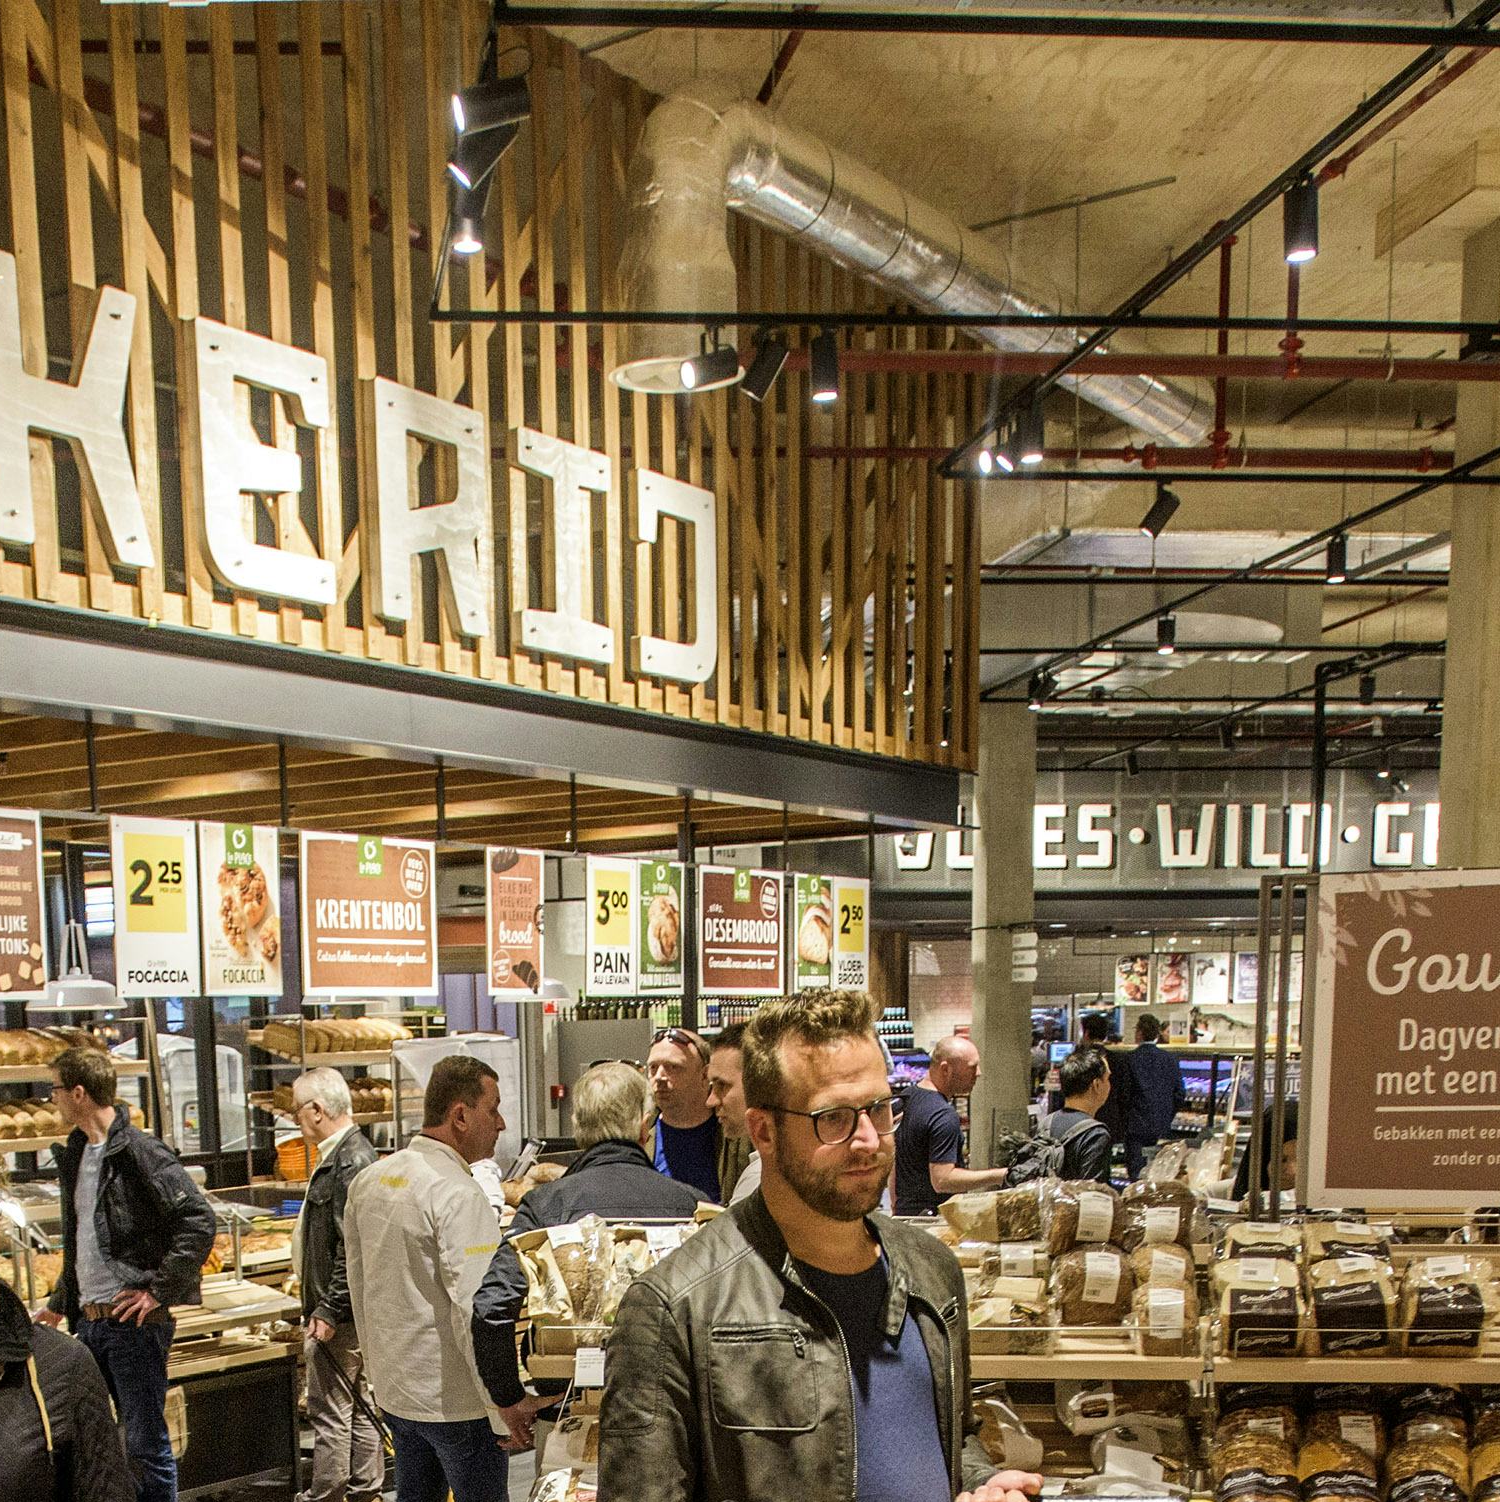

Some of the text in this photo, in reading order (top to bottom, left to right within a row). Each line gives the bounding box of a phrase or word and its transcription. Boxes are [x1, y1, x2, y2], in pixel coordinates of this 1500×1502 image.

[893, 803, 1113, 869] VLES
[1156, 802, 1331, 868] WILD
[315, 899, 426, 931] KRENTENBOL
[499, 921, 534, 945] brood
[704, 918, 778, 944] DESEMBROOD
[593, 952, 630, 974] PAIN
[838, 960, 865, 973] VLOER-
[127, 969, 189, 984] FOCACCIA
[223, 968, 266, 984] FOCACCIA
[605, 975, 630, 985] LEVAIN
[838, 973, 865, 985] BROOD
[1375, 1065, 1437, 1096] met
[1443, 1068, 1498, 1096] een
[1373, 1124, 1444, 1142] Gebakken
[1447, 1125, 1476, 1141] met
[1432, 1149, 1483, 1168] zonder
